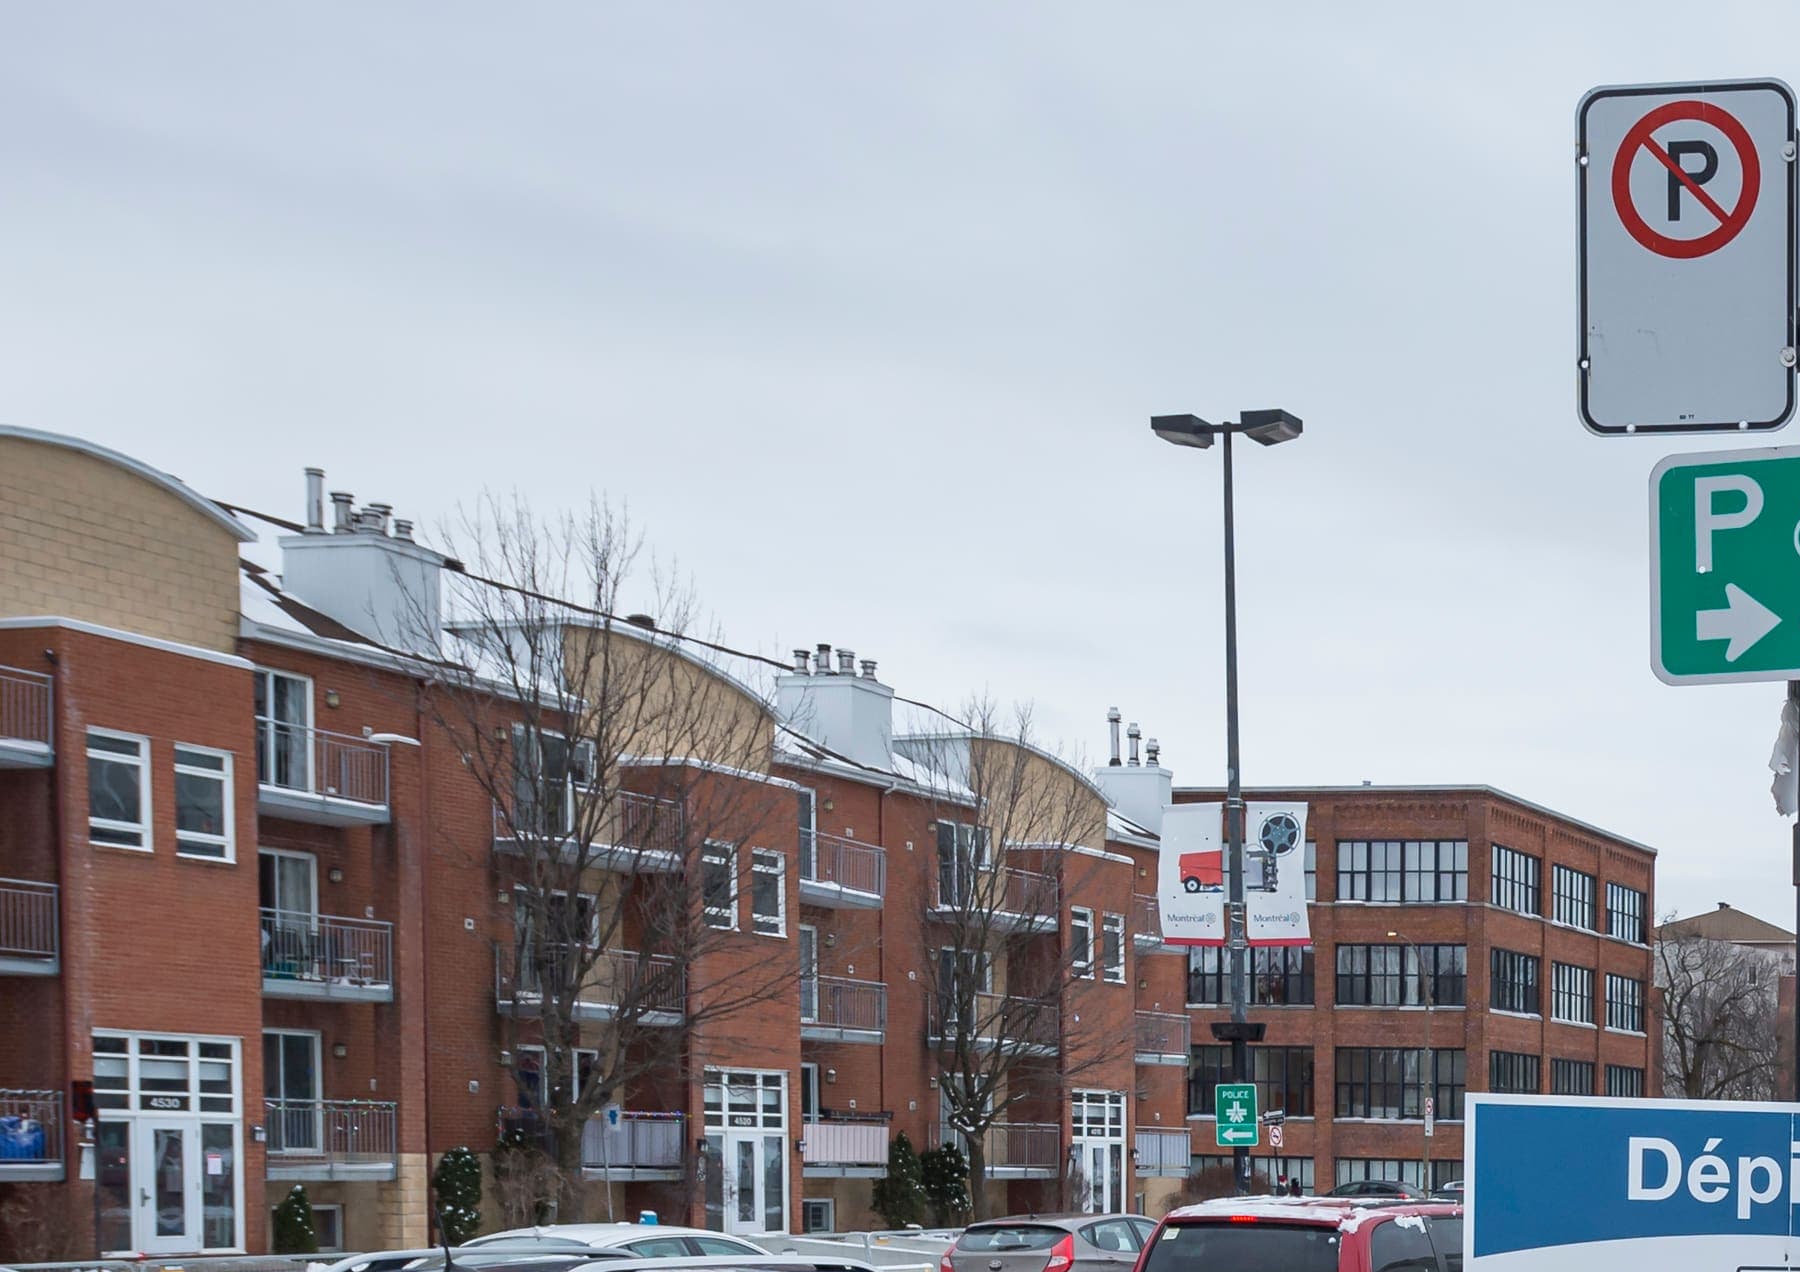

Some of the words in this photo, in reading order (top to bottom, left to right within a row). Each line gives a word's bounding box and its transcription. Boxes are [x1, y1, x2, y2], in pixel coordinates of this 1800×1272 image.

[1667, 140, 1719, 222] P
[1694, 473, 1765, 573] P
[1167, 912, 1205, 923] Montréal
[1253, 912, 1290, 923] Montréal
[1222, 1090, 1249, 1099] POLICE
[150, 1097, 180, 1109] 4530
